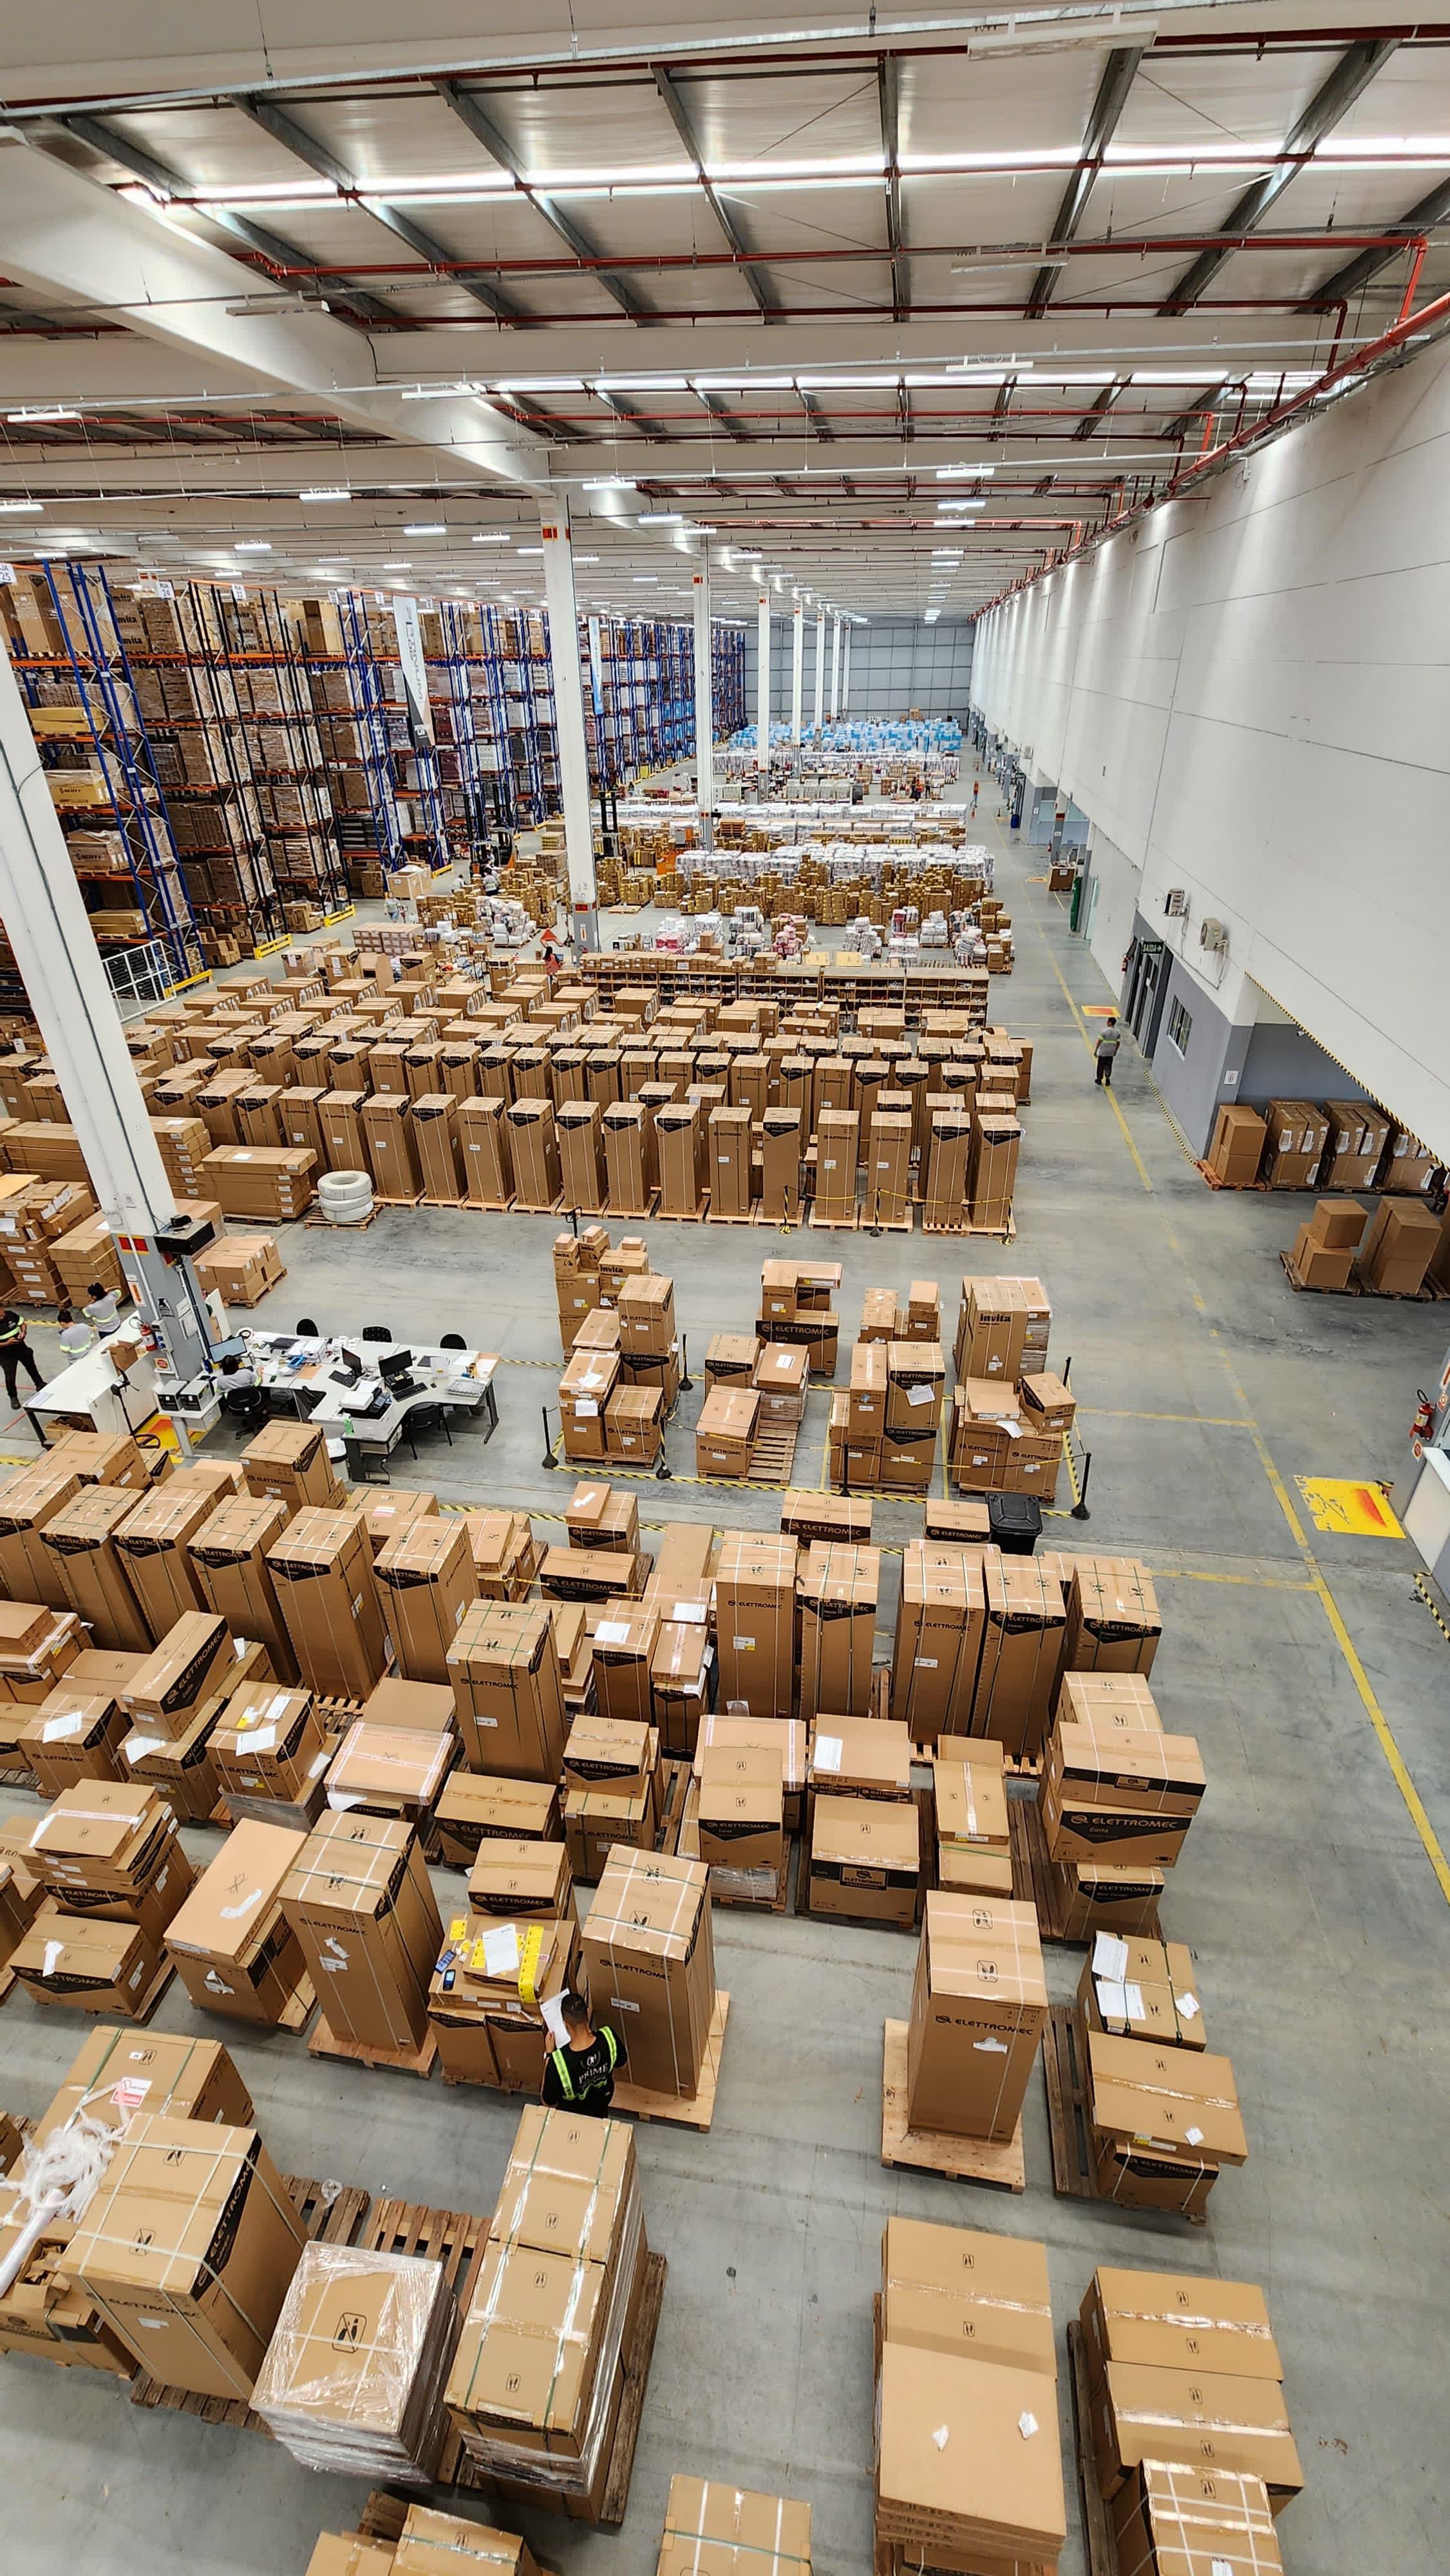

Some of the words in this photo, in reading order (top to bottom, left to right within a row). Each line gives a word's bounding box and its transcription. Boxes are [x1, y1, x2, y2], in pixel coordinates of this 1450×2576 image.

[979, 1313, 1012, 1323] Invita
[802, 1523, 862, 1537] ELETTROMEC
[941, 1531, 983, 1540] ELETTROMEC
[561, 1580, 619, 1593] ELETTROMEC
[925, 1622, 972, 1631] ELETTROMEC
[581, 1762, 632, 1774] ELETTROMEC
[719, 1822, 771, 1830] ELETTROMEC
[1092, 1817, 1178, 1830] ELETTROMEC
[489, 1897, 546, 1907] ELETTROMEC
[955, 2018, 1034, 2036] ELETTROMEC
[579, 2062, 608, 2085] PRIME
